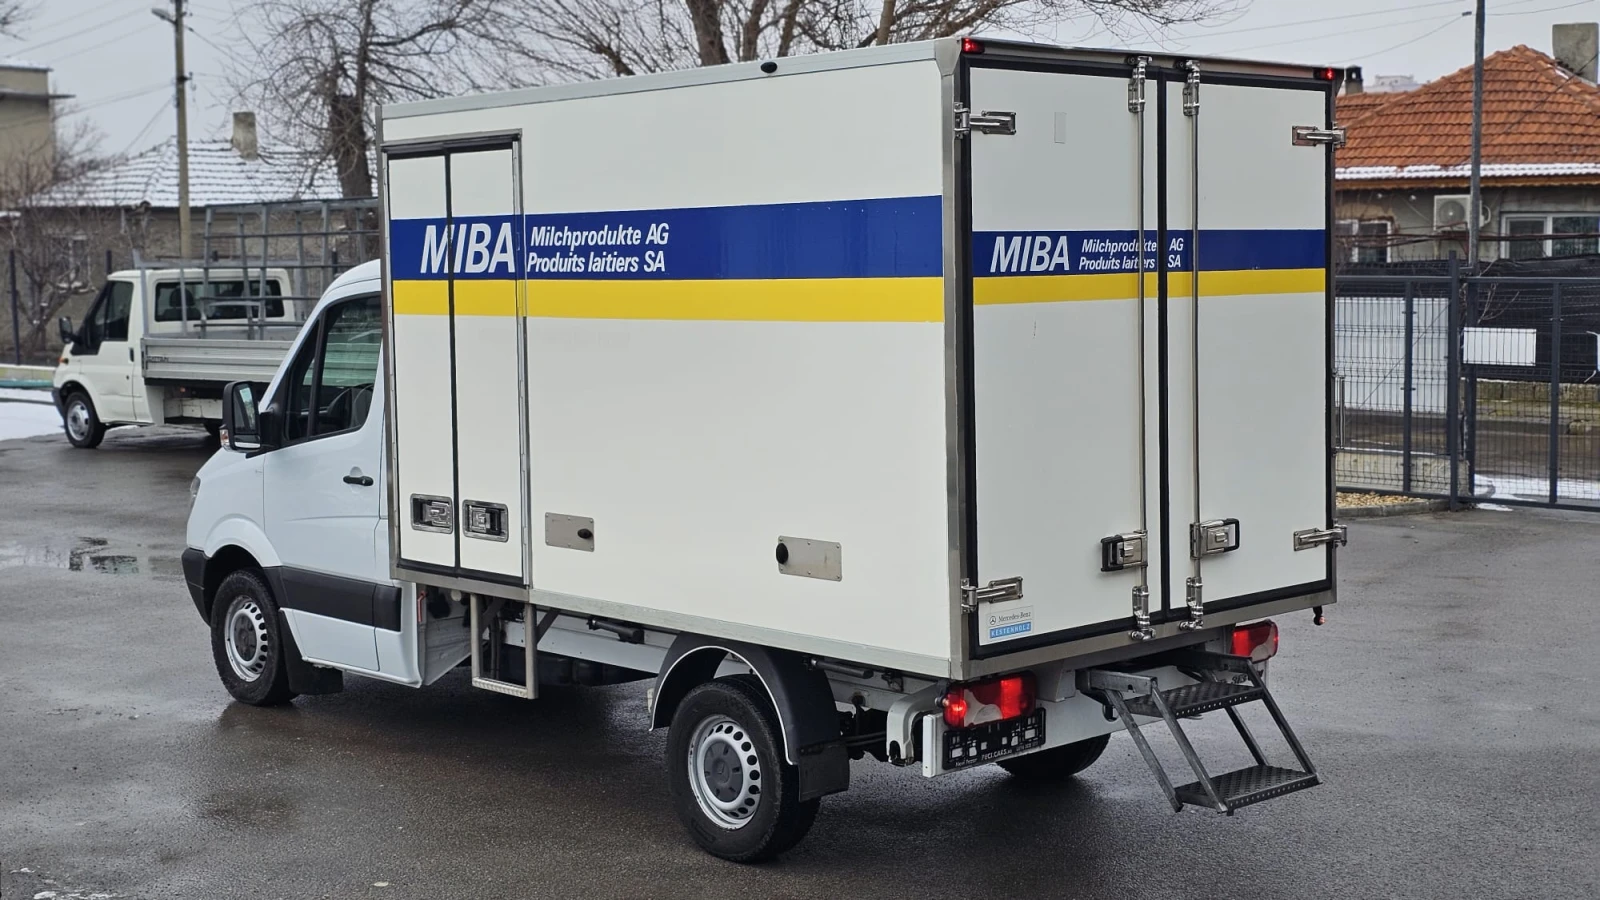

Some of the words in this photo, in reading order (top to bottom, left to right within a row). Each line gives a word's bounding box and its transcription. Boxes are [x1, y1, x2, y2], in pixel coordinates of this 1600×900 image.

[420, 222, 516, 274] MIBA
[530, 224, 642, 252] Milchprodukte
[645, 223, 670, 245] AG
[1169, 237, 1184, 252] AG
[527, 252, 585, 273] Produits
[587, 251, 639, 272] laitiers
[643, 250, 666, 272] SA
[990, 235, 1070, 273] MIBA
[1078, 255, 1121, 271] Produits
[1122, 255, 1156, 270] laiters
[1167, 254, 1182, 268] SA
[991, 624, 1031, 637] KESTENHOLZ
